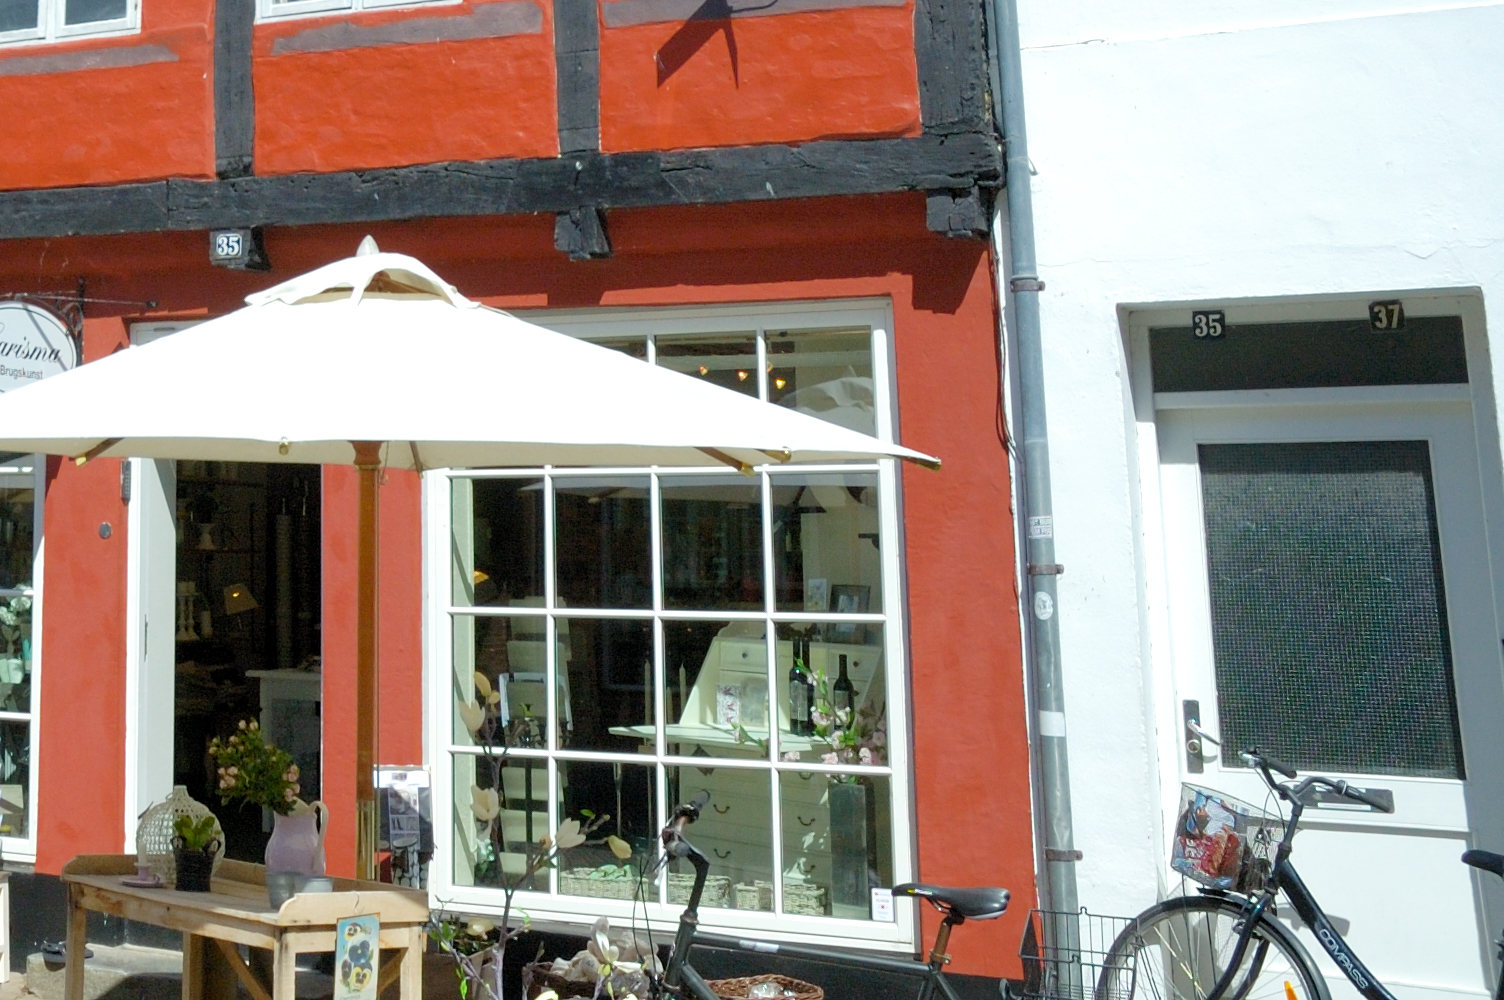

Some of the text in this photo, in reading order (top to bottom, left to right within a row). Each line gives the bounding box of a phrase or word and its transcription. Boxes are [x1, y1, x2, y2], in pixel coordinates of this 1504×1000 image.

[218, 236, 240, 256] 35
[1194, 313, 1223, 338] 35
[1372, 304, 1401, 330] 37
[0, 364, 44, 380] Brugskunst
[1319, 928, 1369, 990] COMPASS
